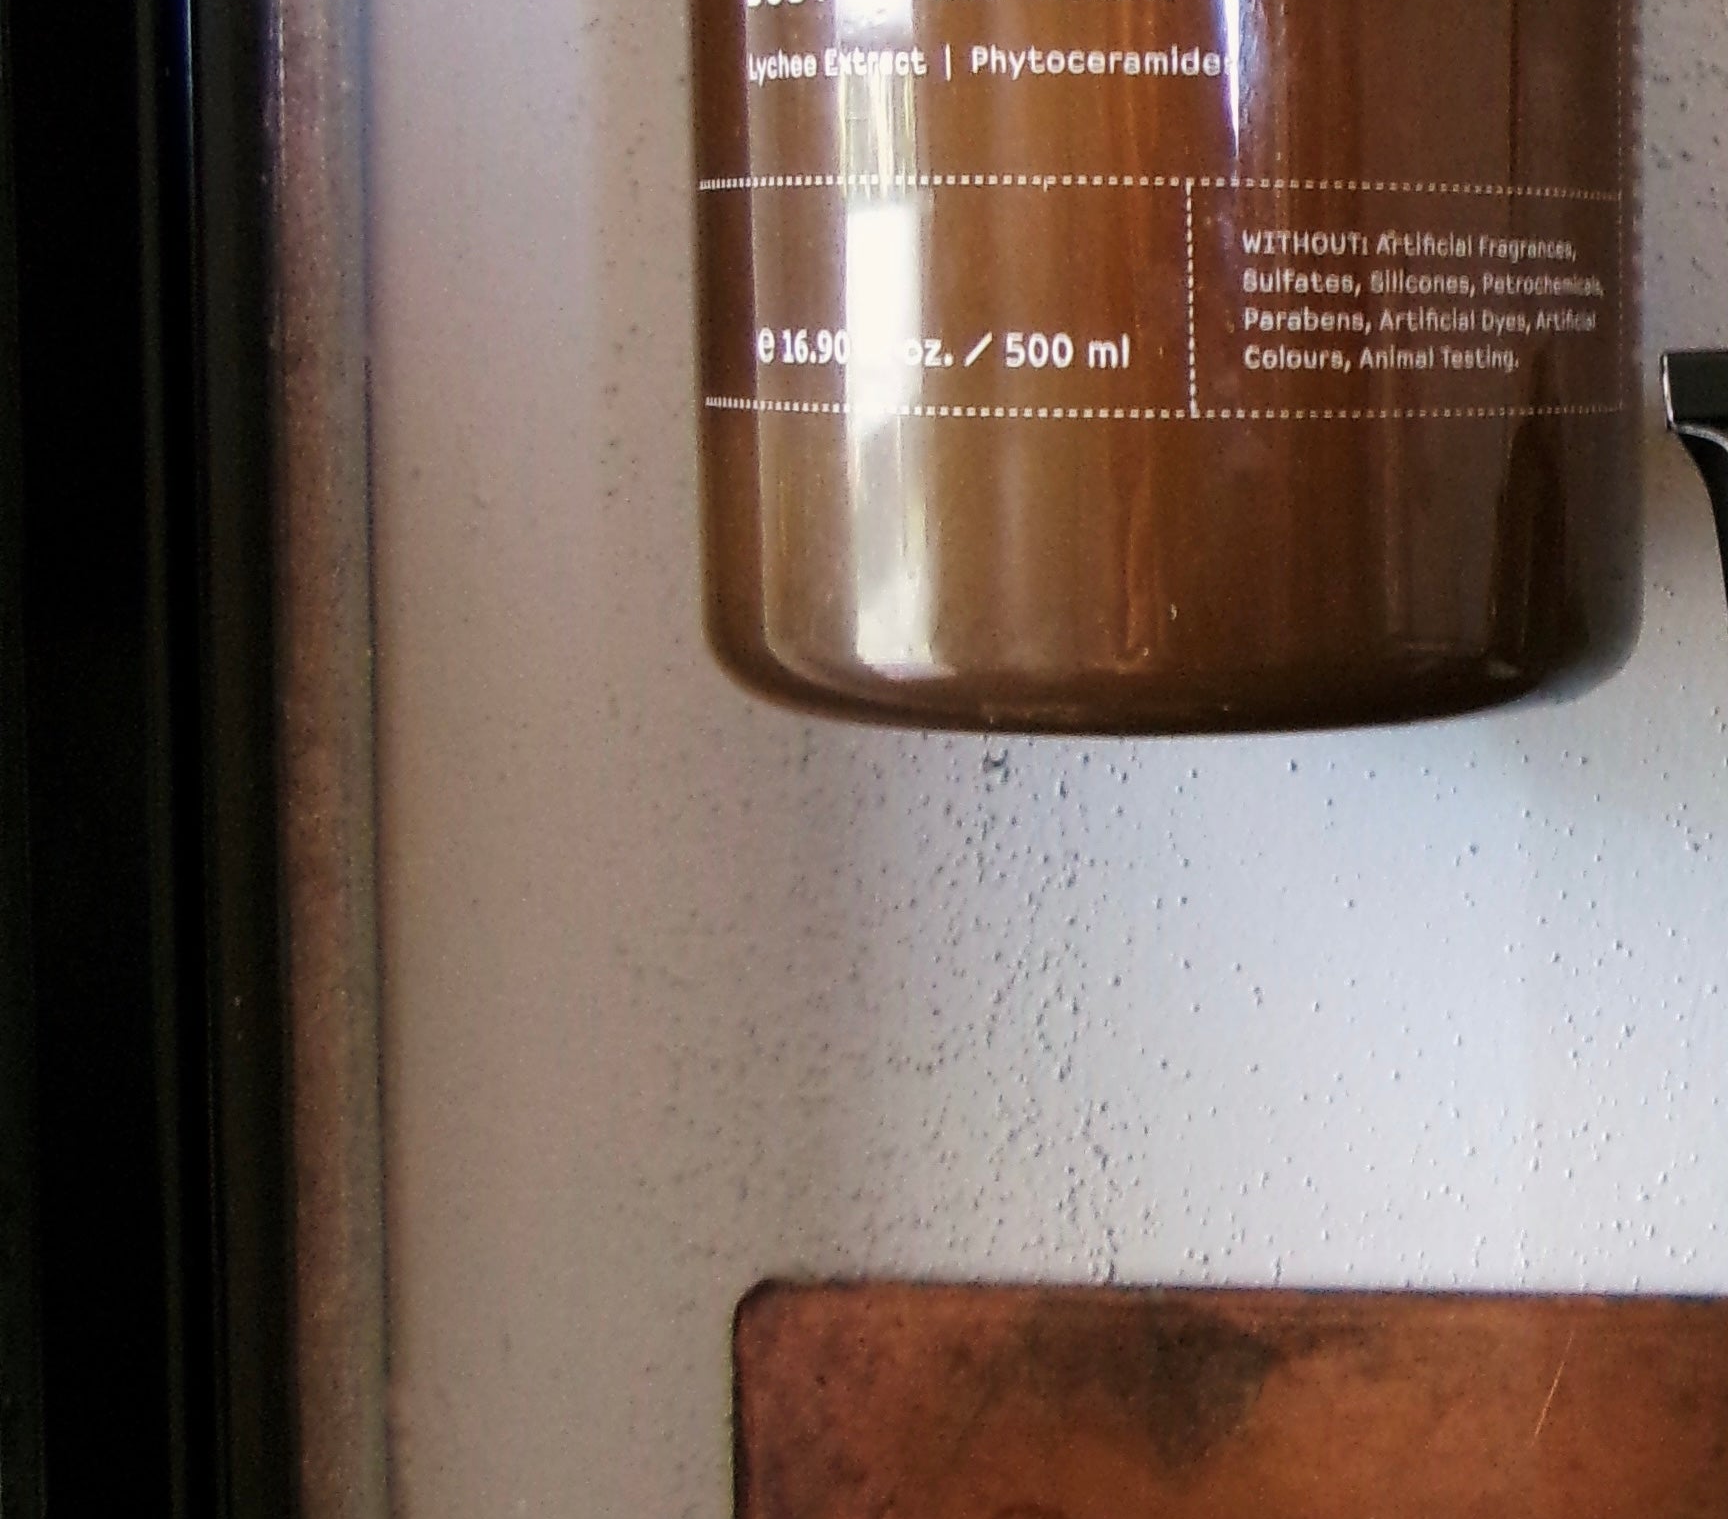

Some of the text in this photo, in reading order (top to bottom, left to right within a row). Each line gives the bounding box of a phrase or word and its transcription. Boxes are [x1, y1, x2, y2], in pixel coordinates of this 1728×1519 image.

[748, 48, 817, 88] Lychee
[823, 46, 927, 78] Extract
[1242, 229, 1577, 264] WITHOUT: Artificial Fragrances,
[1242, 267, 1362, 298] Sulfates,
[1370, 268, 1476, 298] Silicones,
[1243, 305, 1372, 336] Parabens,
[1379, 305, 1476, 332] Artificial
[1481, 308, 1532, 337] Dyes,
[782, 328, 851, 365] 16.90
[904, 338, 954, 368] oz.
[1004, 332, 1074, 369] 500
[1087, 333, 1130, 369] ml
[1244, 343, 1520, 374] Colours, Animal Testing.
